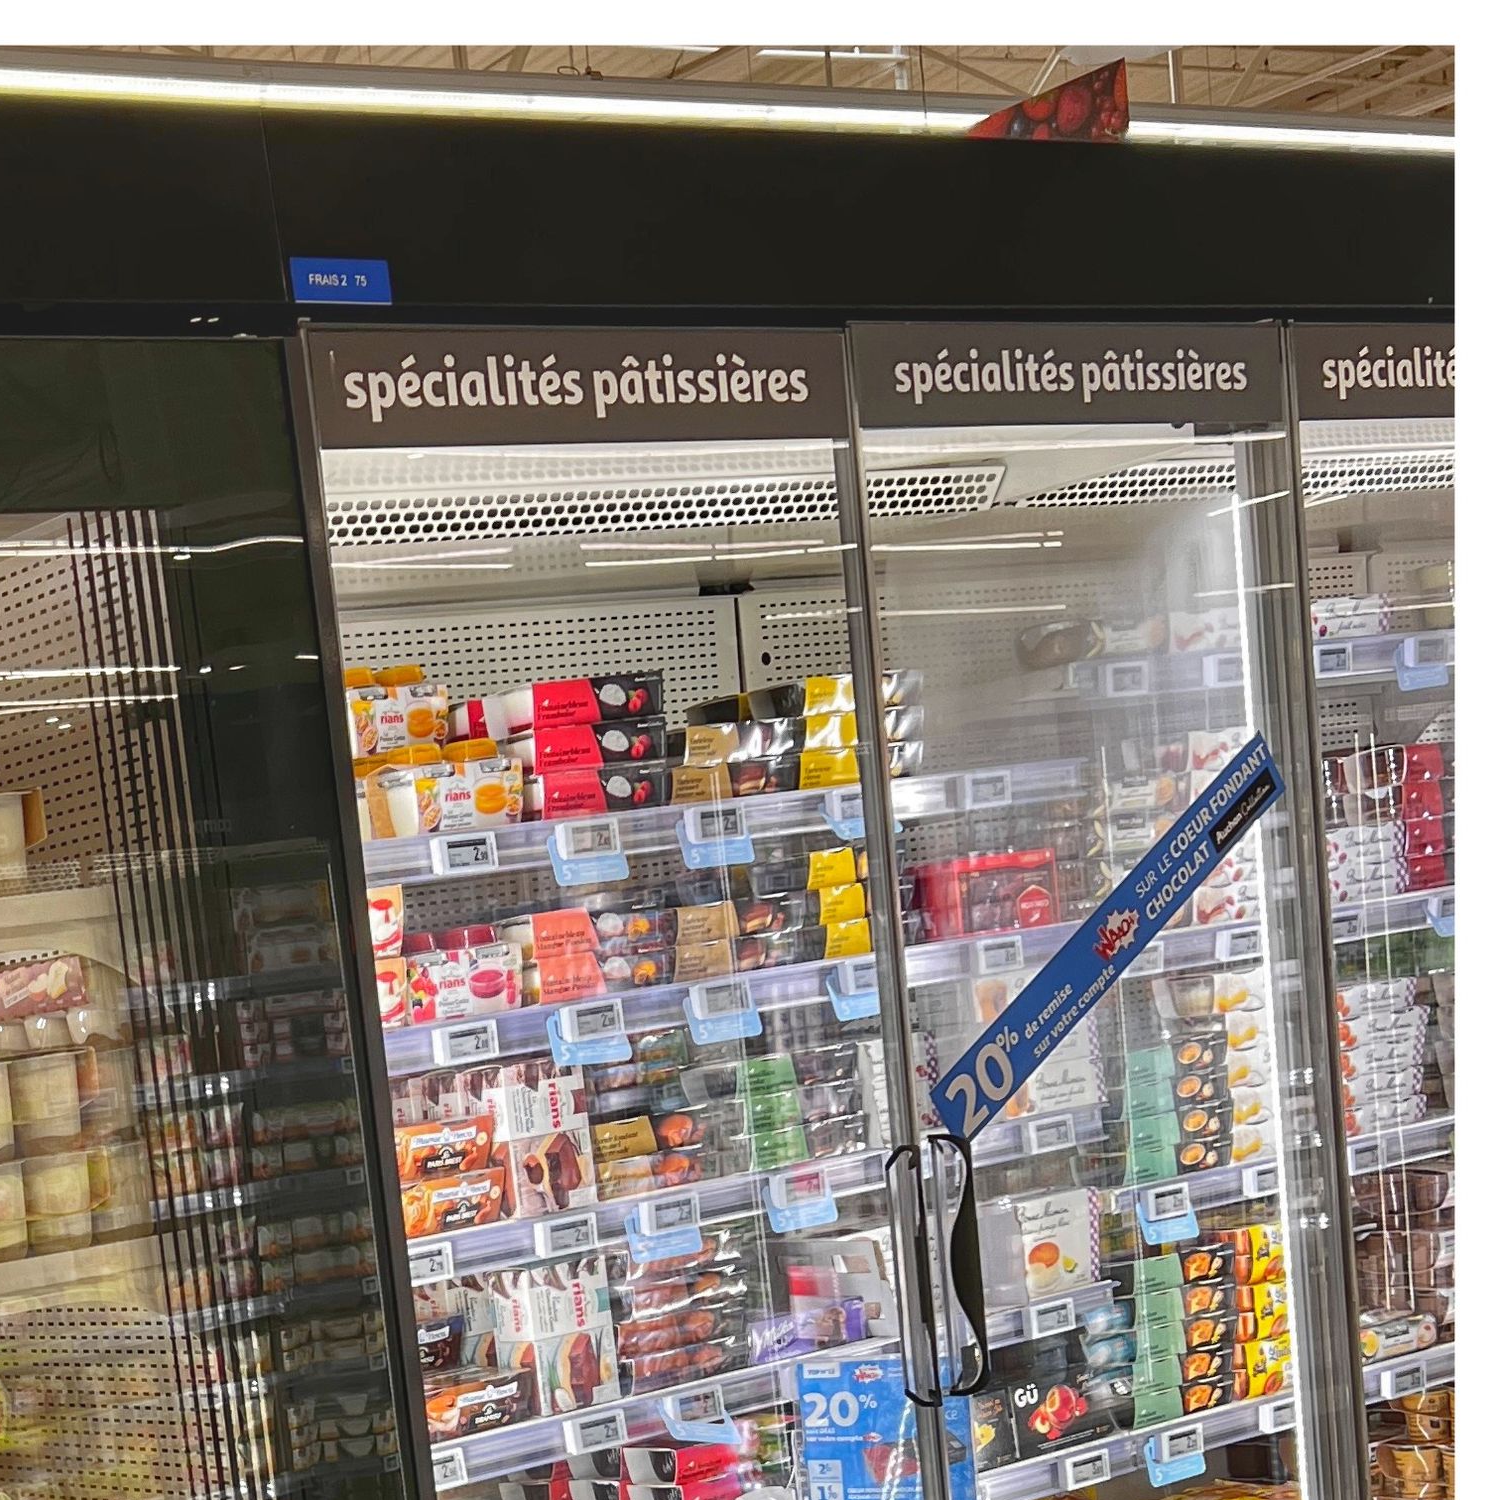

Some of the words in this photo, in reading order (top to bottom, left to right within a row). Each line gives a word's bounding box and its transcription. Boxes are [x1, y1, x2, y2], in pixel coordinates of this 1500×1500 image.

[308, 274, 339, 286] FRAIS
[341, 274, 347, 286] 2
[355, 275, 367, 287] 75
[345, 353, 584, 423] spécialités
[594, 353, 808, 418] pâtissières
[894, 348, 1075, 405] spécialités
[1082, 349, 1248, 403] pâtissières
[380, 713, 404, 724] rians
[445, 790, 471, 801] rians
[1134, 870, 1158, 898] SUR
[1157, 853, 1173, 874] LE
[1170, 810, 1213, 861] COEUR
[1209, 742, 1268, 816] FONDANT
[1145, 840, 1211, 921] CHOCOLAT
[438, 977, 466, 989] rians
[1024, 1019, 1039, 1040] de
[1038, 983, 1074, 1021] remise
[1033, 1035, 1052, 1058] sur
[1050, 1002, 1079, 1037] votre
[1077, 964, 1116, 1009] compte
[548, 1082, 562, 1130] rians
[1014, 1383, 1039, 1409] GÜ
